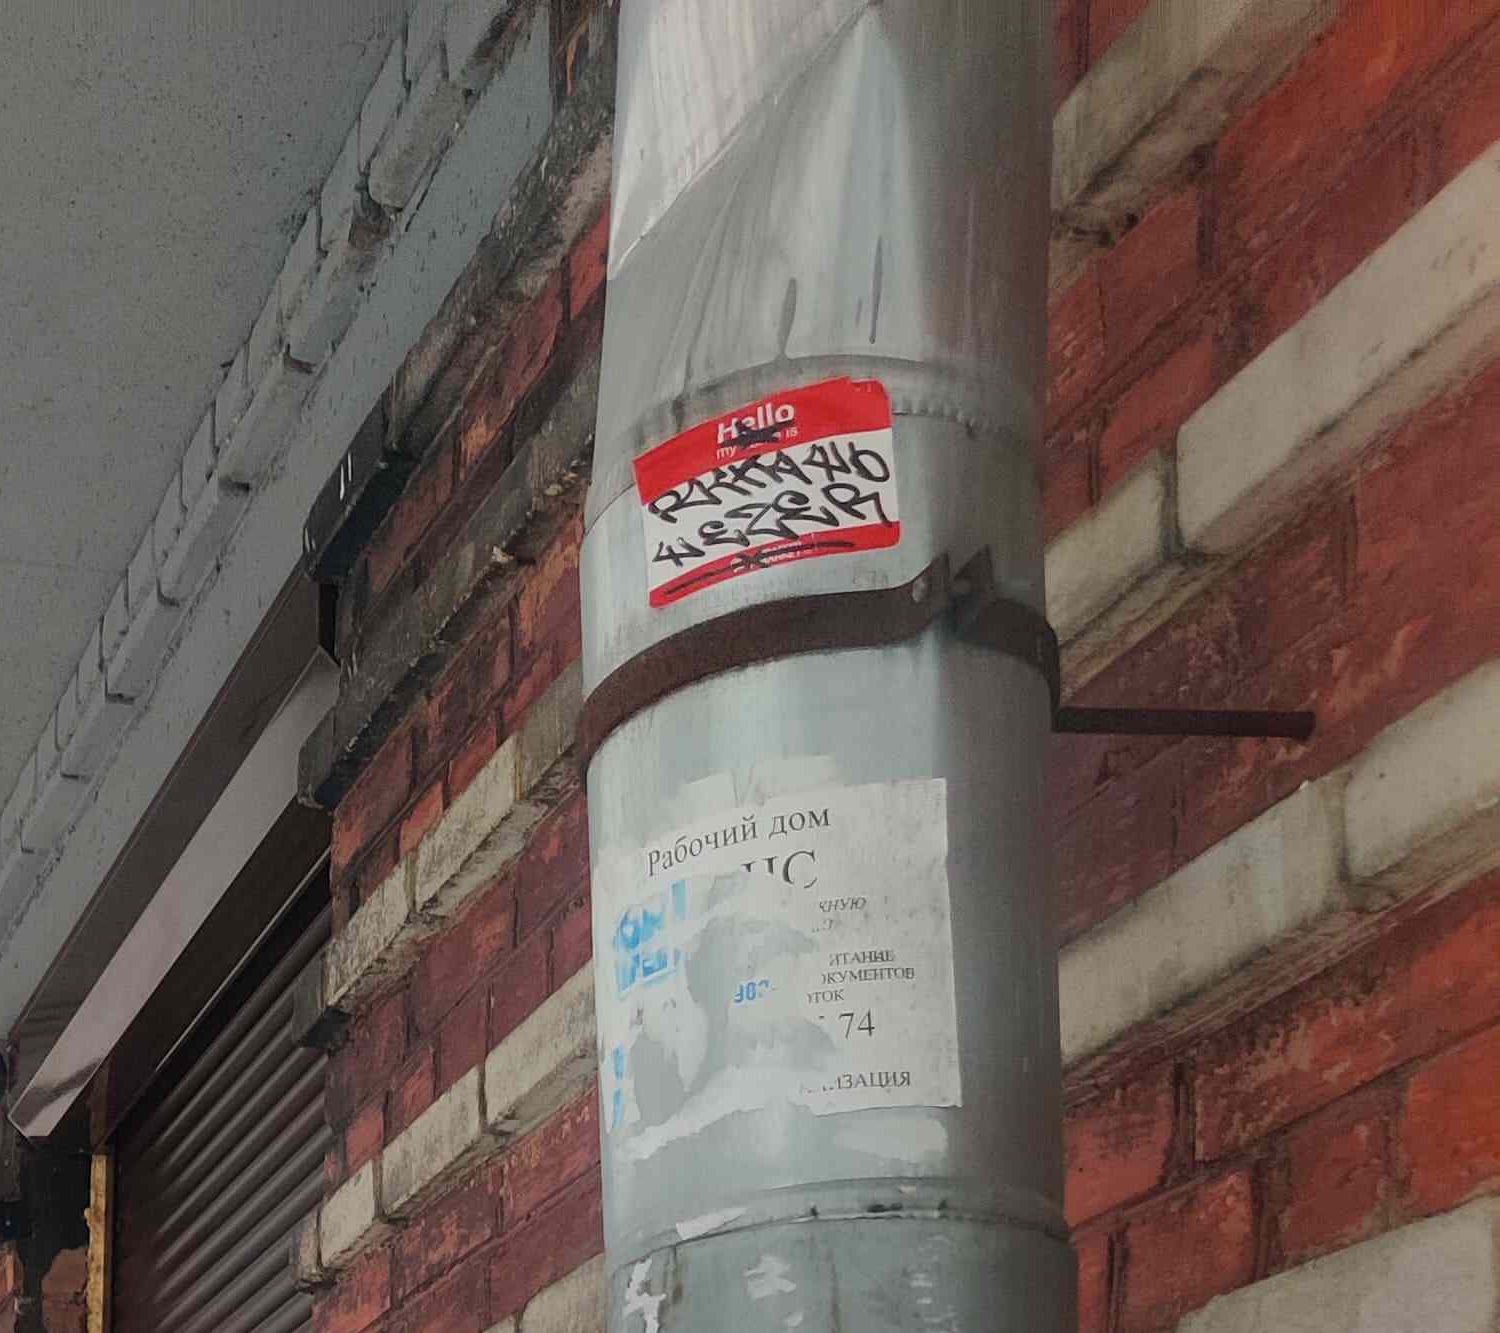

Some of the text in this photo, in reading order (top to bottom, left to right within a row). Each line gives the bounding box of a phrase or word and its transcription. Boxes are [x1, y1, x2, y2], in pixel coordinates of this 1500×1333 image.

[717, 403, 795, 444] Hello
[716, 445, 737, 460] my
[647, 807, 831, 878] Рабочий дом
[838, 1008, 875, 1039] 74
